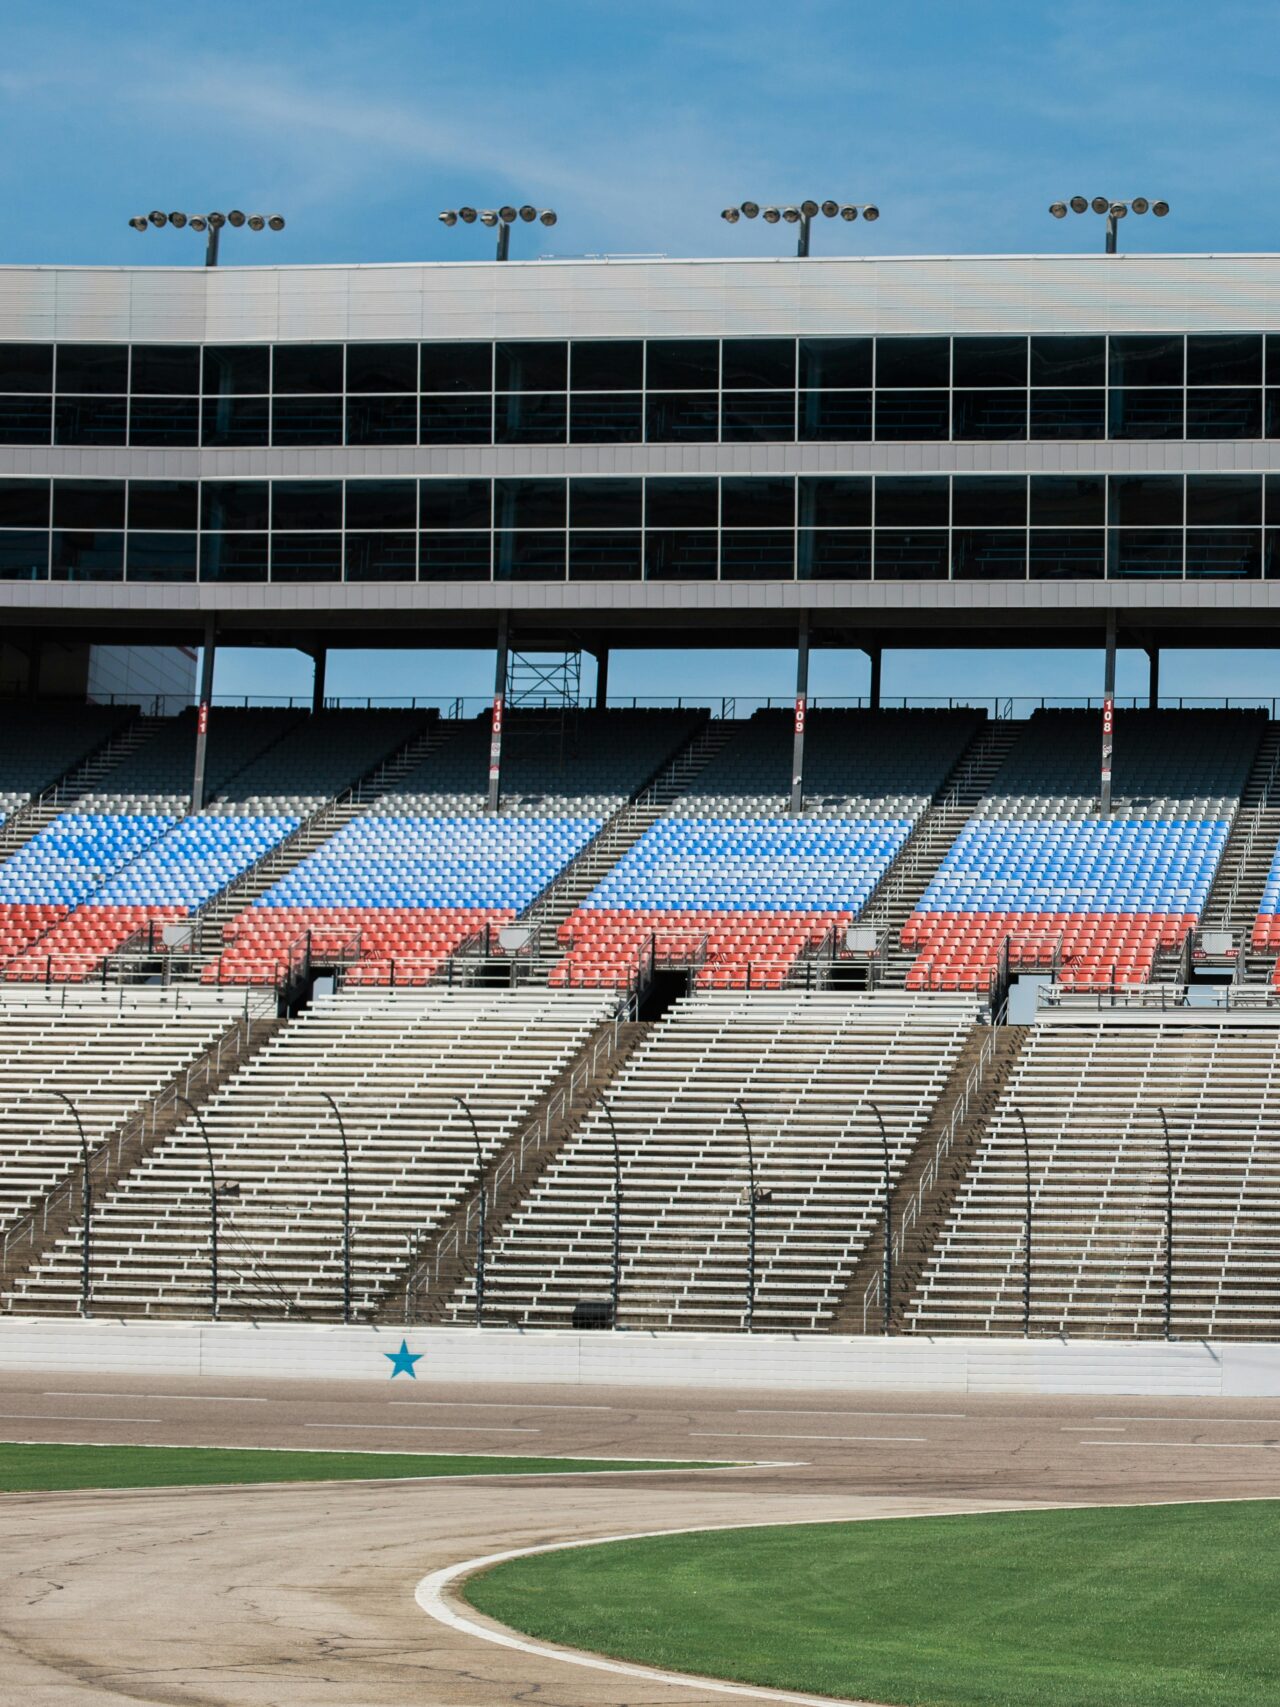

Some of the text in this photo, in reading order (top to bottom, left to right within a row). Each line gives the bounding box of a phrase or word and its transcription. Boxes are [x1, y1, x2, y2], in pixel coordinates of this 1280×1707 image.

[493, 700, 501, 732] 110
[796, 700, 804, 732] 109
[1103, 700, 1112, 732] 108
